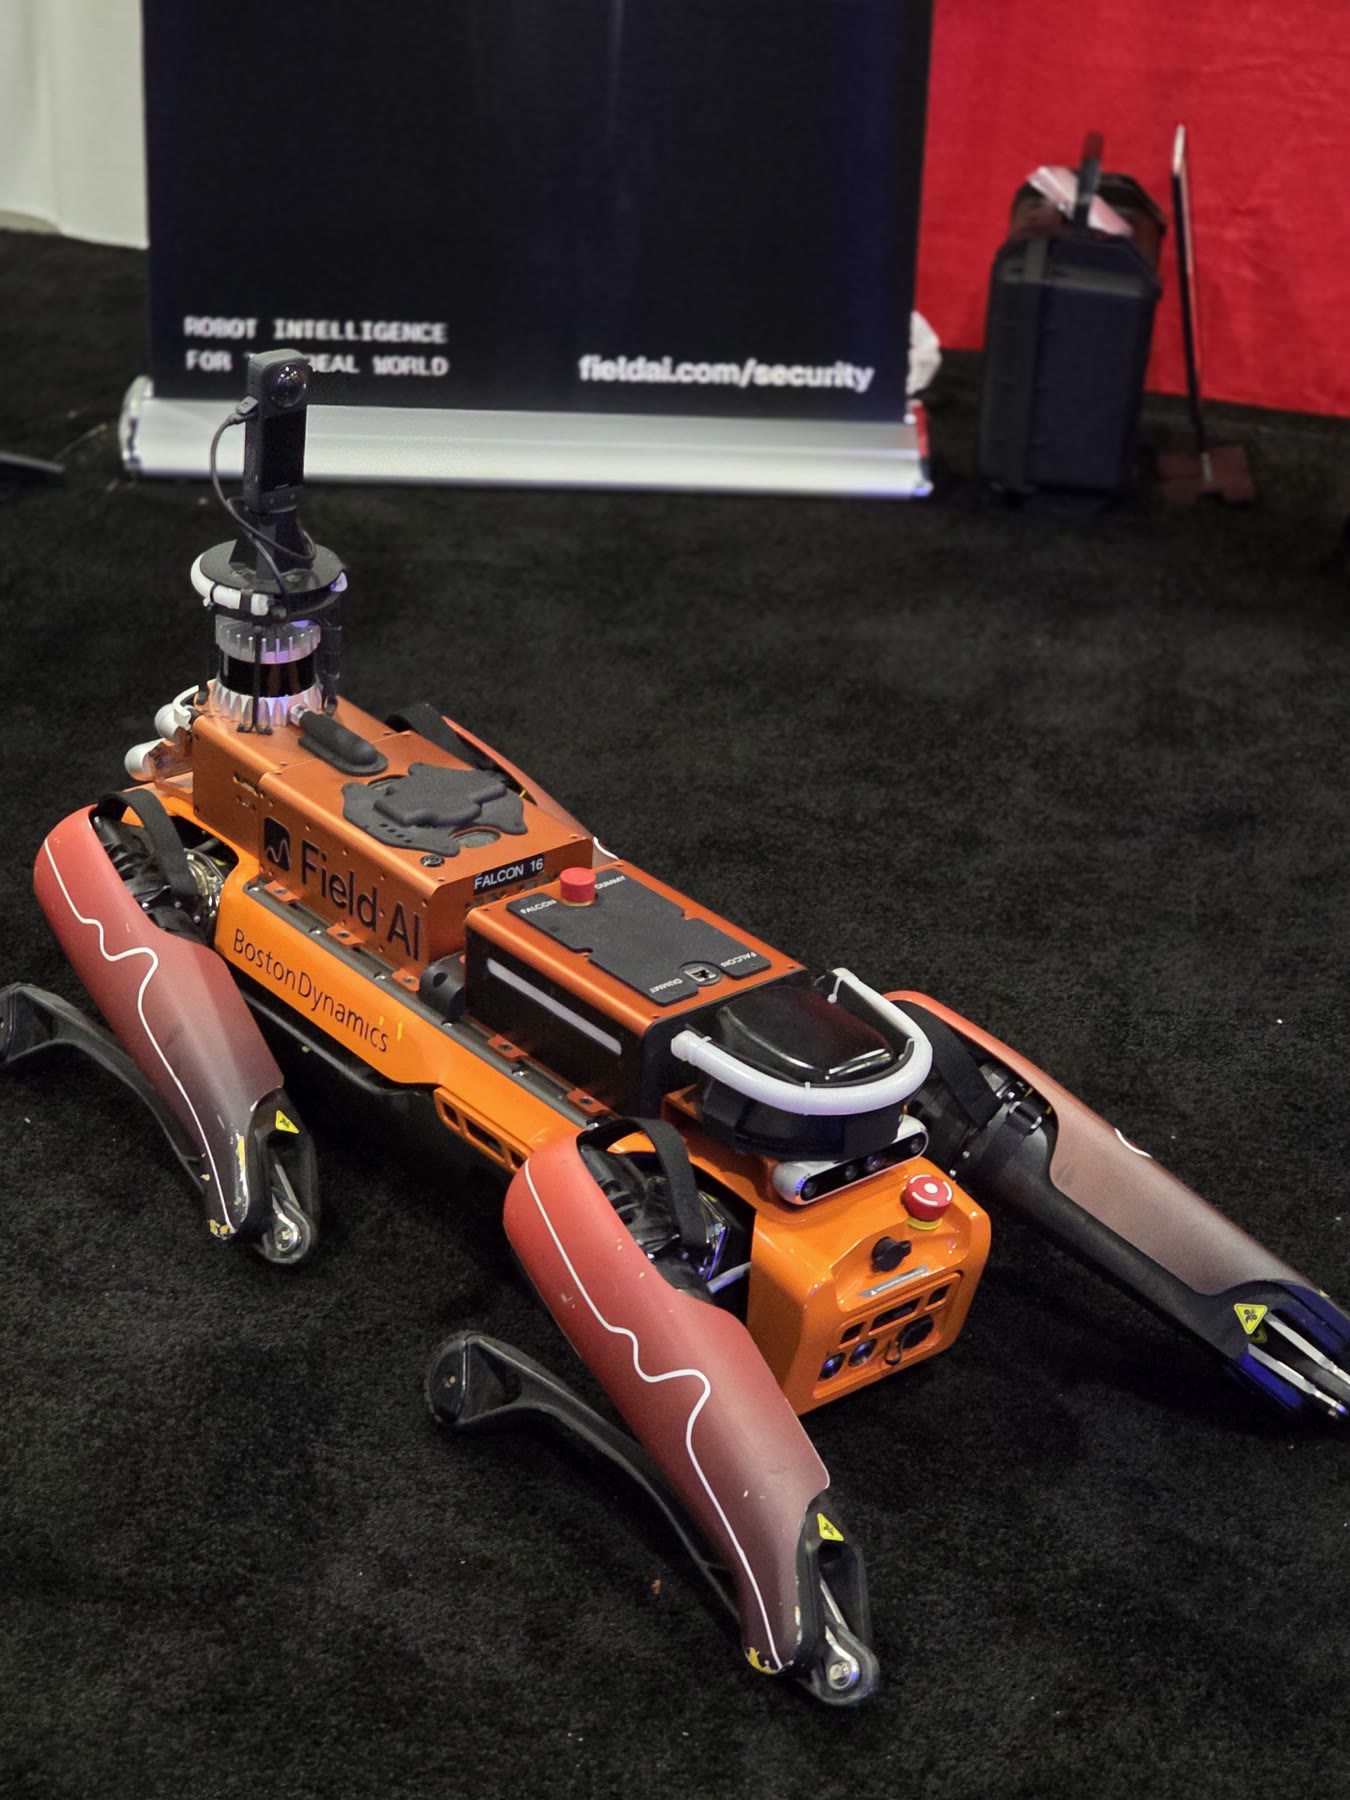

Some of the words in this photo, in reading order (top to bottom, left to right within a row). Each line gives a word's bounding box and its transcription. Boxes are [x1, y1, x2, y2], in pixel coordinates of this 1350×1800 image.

[184, 315, 257, 338] ROBOT
[273, 318, 447, 343] INTELLIGENCE
[186, 350, 232, 371] FOR
[372, 356, 449, 376] WORLD
[578, 355, 875, 393] fieldai.com/security
[474, 864, 524, 890] FALCON
[530, 858, 544, 872] 16
[301, 840, 377, 932] Field
[387, 902, 420, 962] AI
[520, 899, 557, 914] FALCON
[720, 951, 757, 968] FALCON
